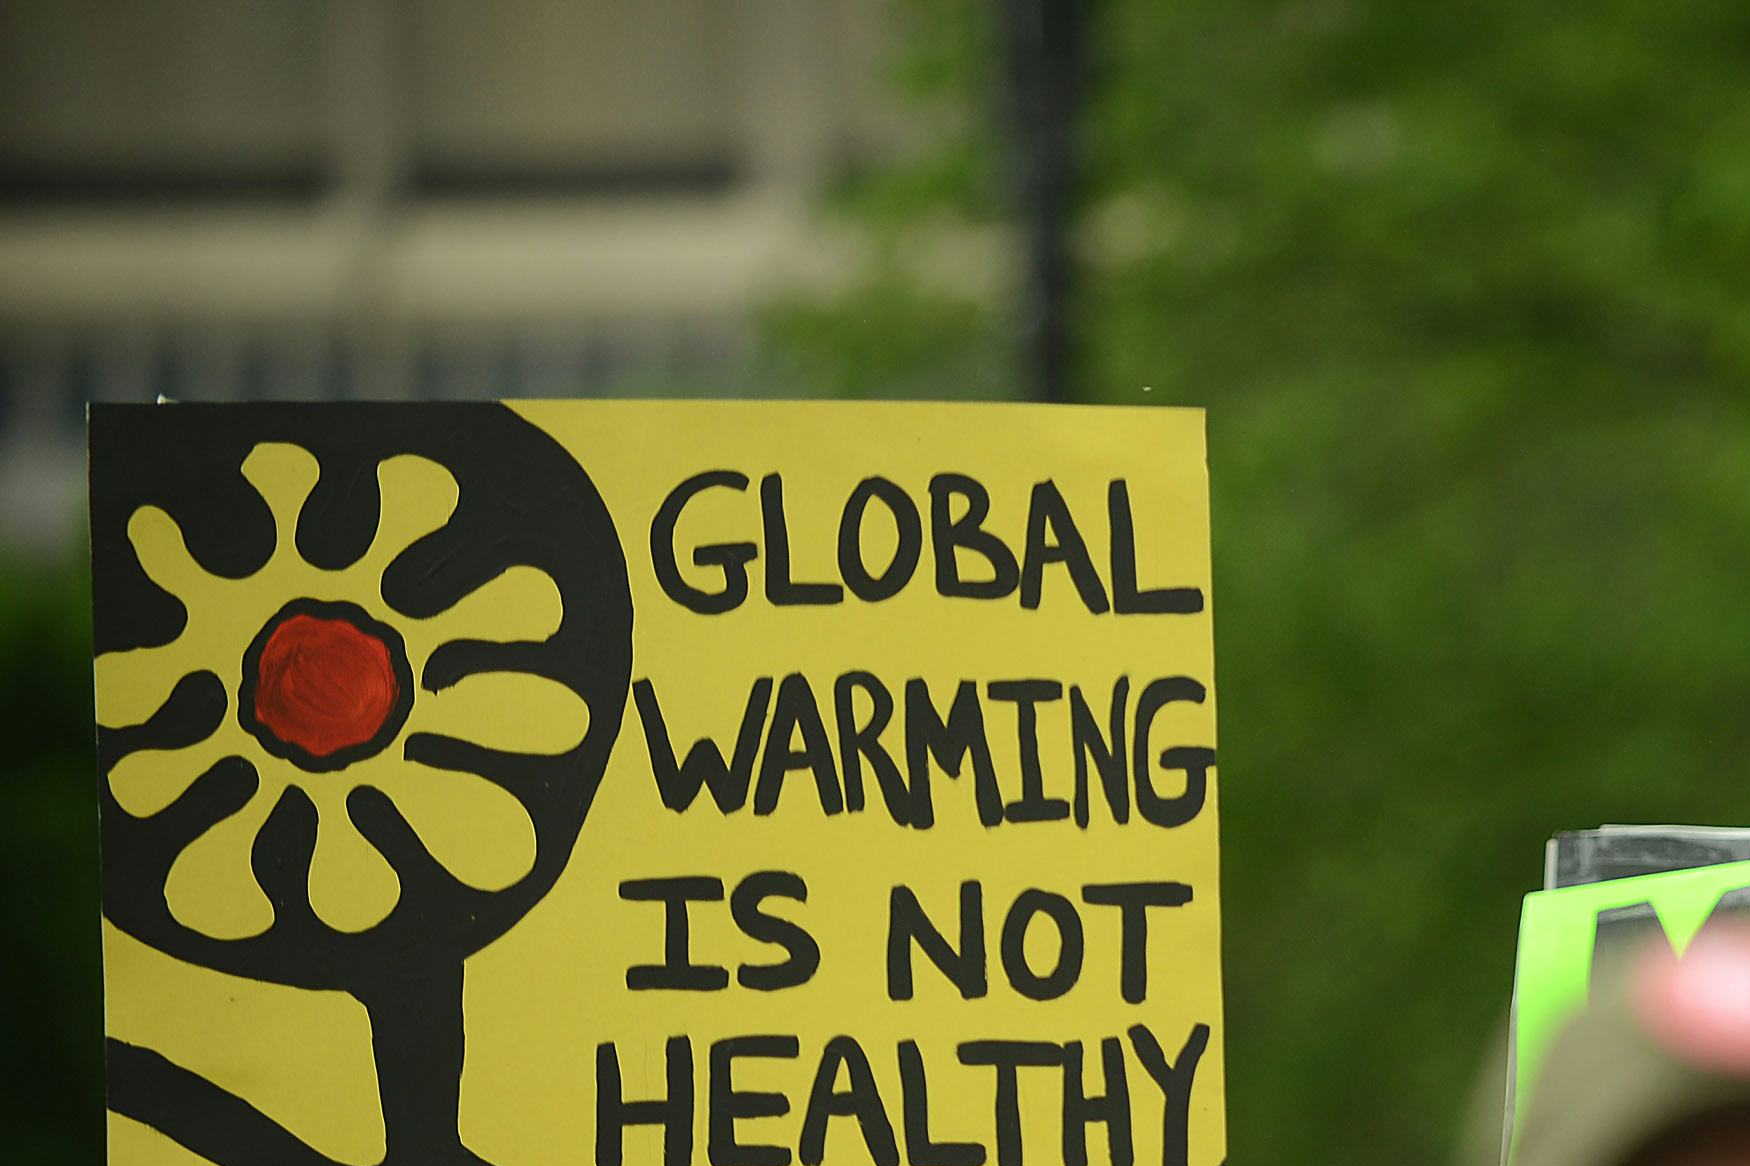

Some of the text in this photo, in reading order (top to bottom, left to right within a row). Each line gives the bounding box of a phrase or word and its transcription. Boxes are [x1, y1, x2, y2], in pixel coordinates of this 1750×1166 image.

[650, 470, 1204, 615] GLOBAL
[632, 670, 1217, 830] WARMING
[618, 871, 1193, 1004] IS NOT
